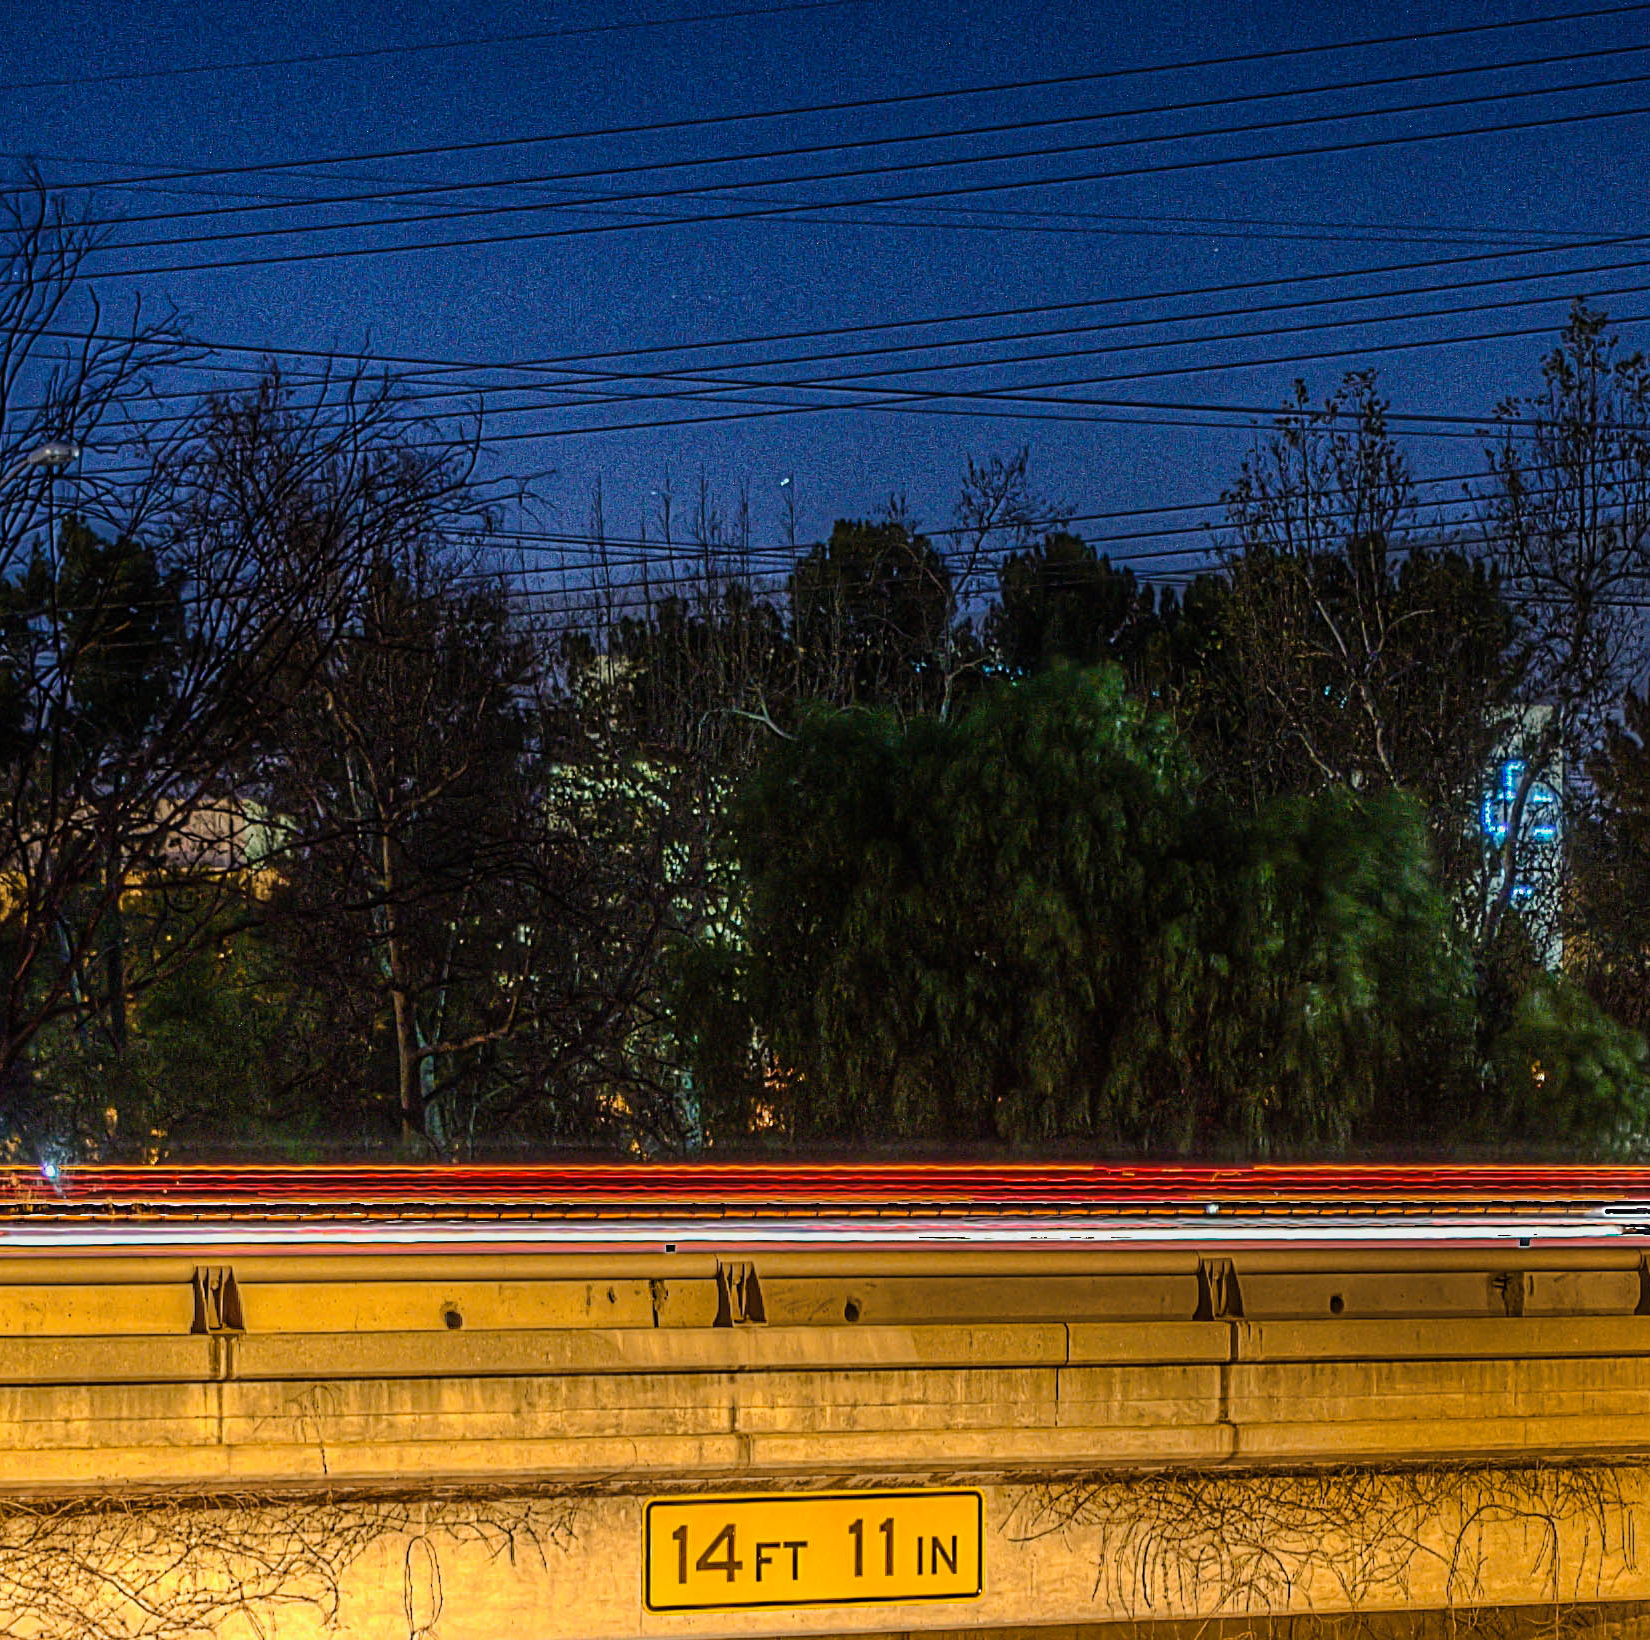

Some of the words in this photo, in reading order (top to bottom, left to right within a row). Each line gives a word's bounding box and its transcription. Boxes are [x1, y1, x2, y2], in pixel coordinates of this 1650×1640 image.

[672, 1523, 743, 1584] 14
[755, 1540, 808, 1582] FT
[848, 1517, 895, 1577] 11
[917, 1535, 958, 1576] IN
